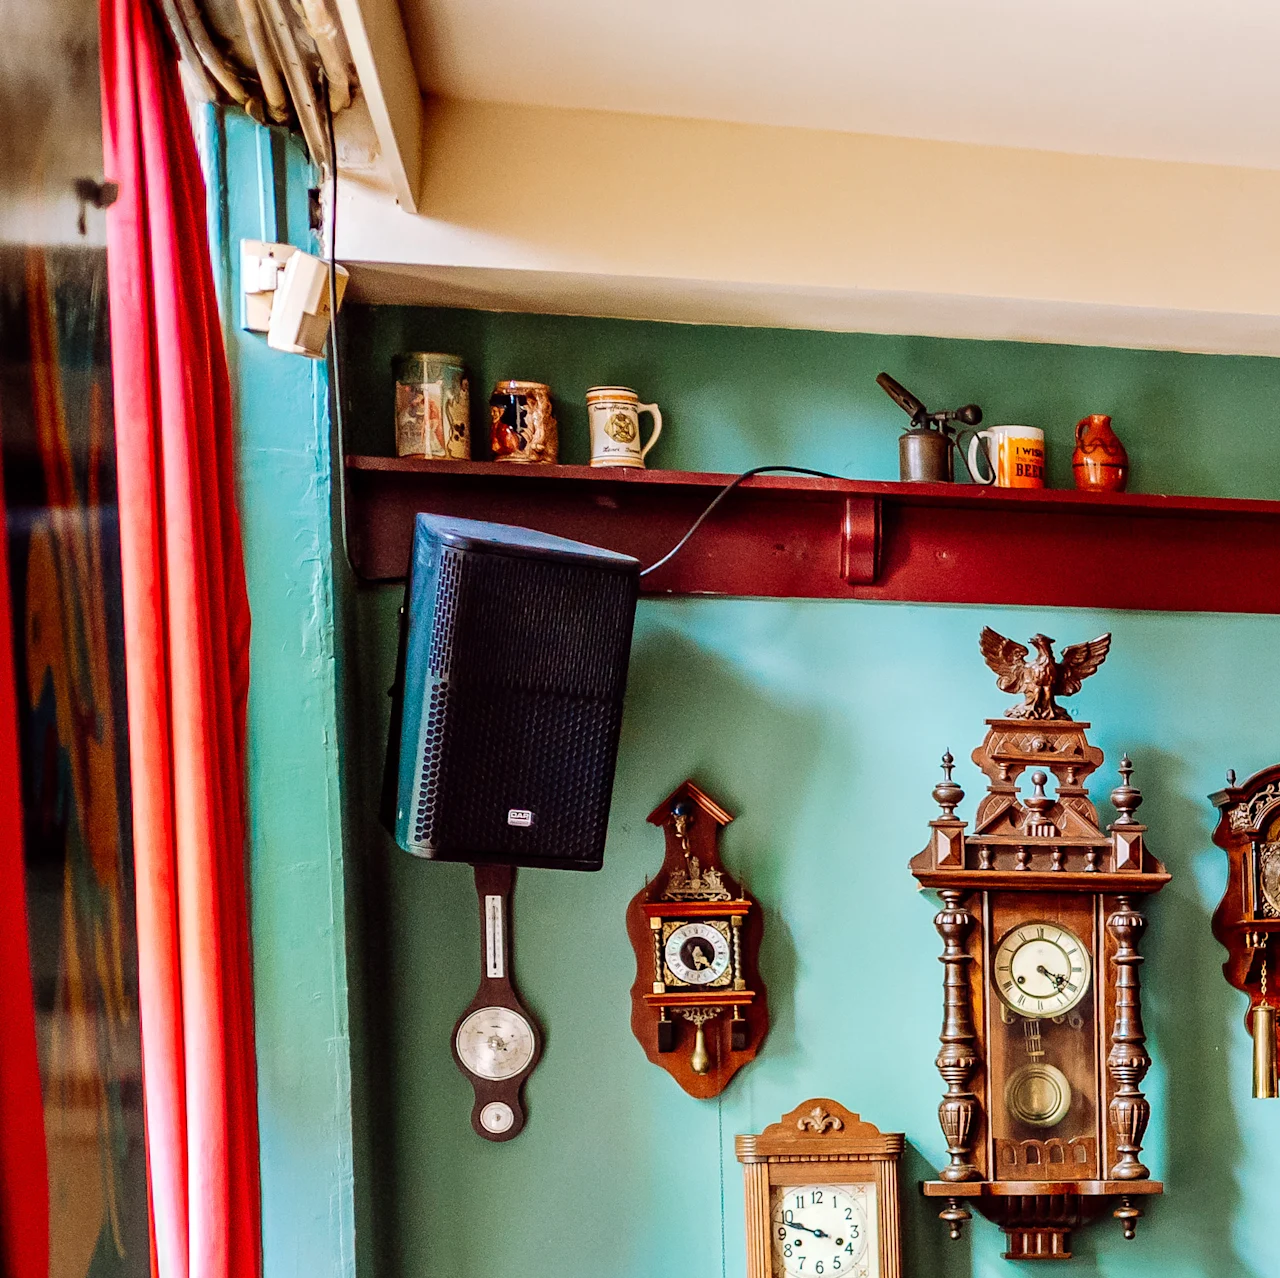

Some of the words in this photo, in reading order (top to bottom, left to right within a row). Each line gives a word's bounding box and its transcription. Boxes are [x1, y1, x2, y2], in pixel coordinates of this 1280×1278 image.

[795, 1196, 805, 1209] 11
[811, 1191, 823, 1205] 12
[781, 1209, 794, 1224] 10
[844, 1208, 852, 1220] 2
[777, 1227, 787, 1241] 9
[850, 1225, 859, 1239] 3
[783, 1244, 793, 1258] 8
[844, 1242, 854, 1255] 4
[798, 1257, 806, 1270] 7
[816, 1261, 824, 1275] 6
[833, 1256, 842, 1270] 5
